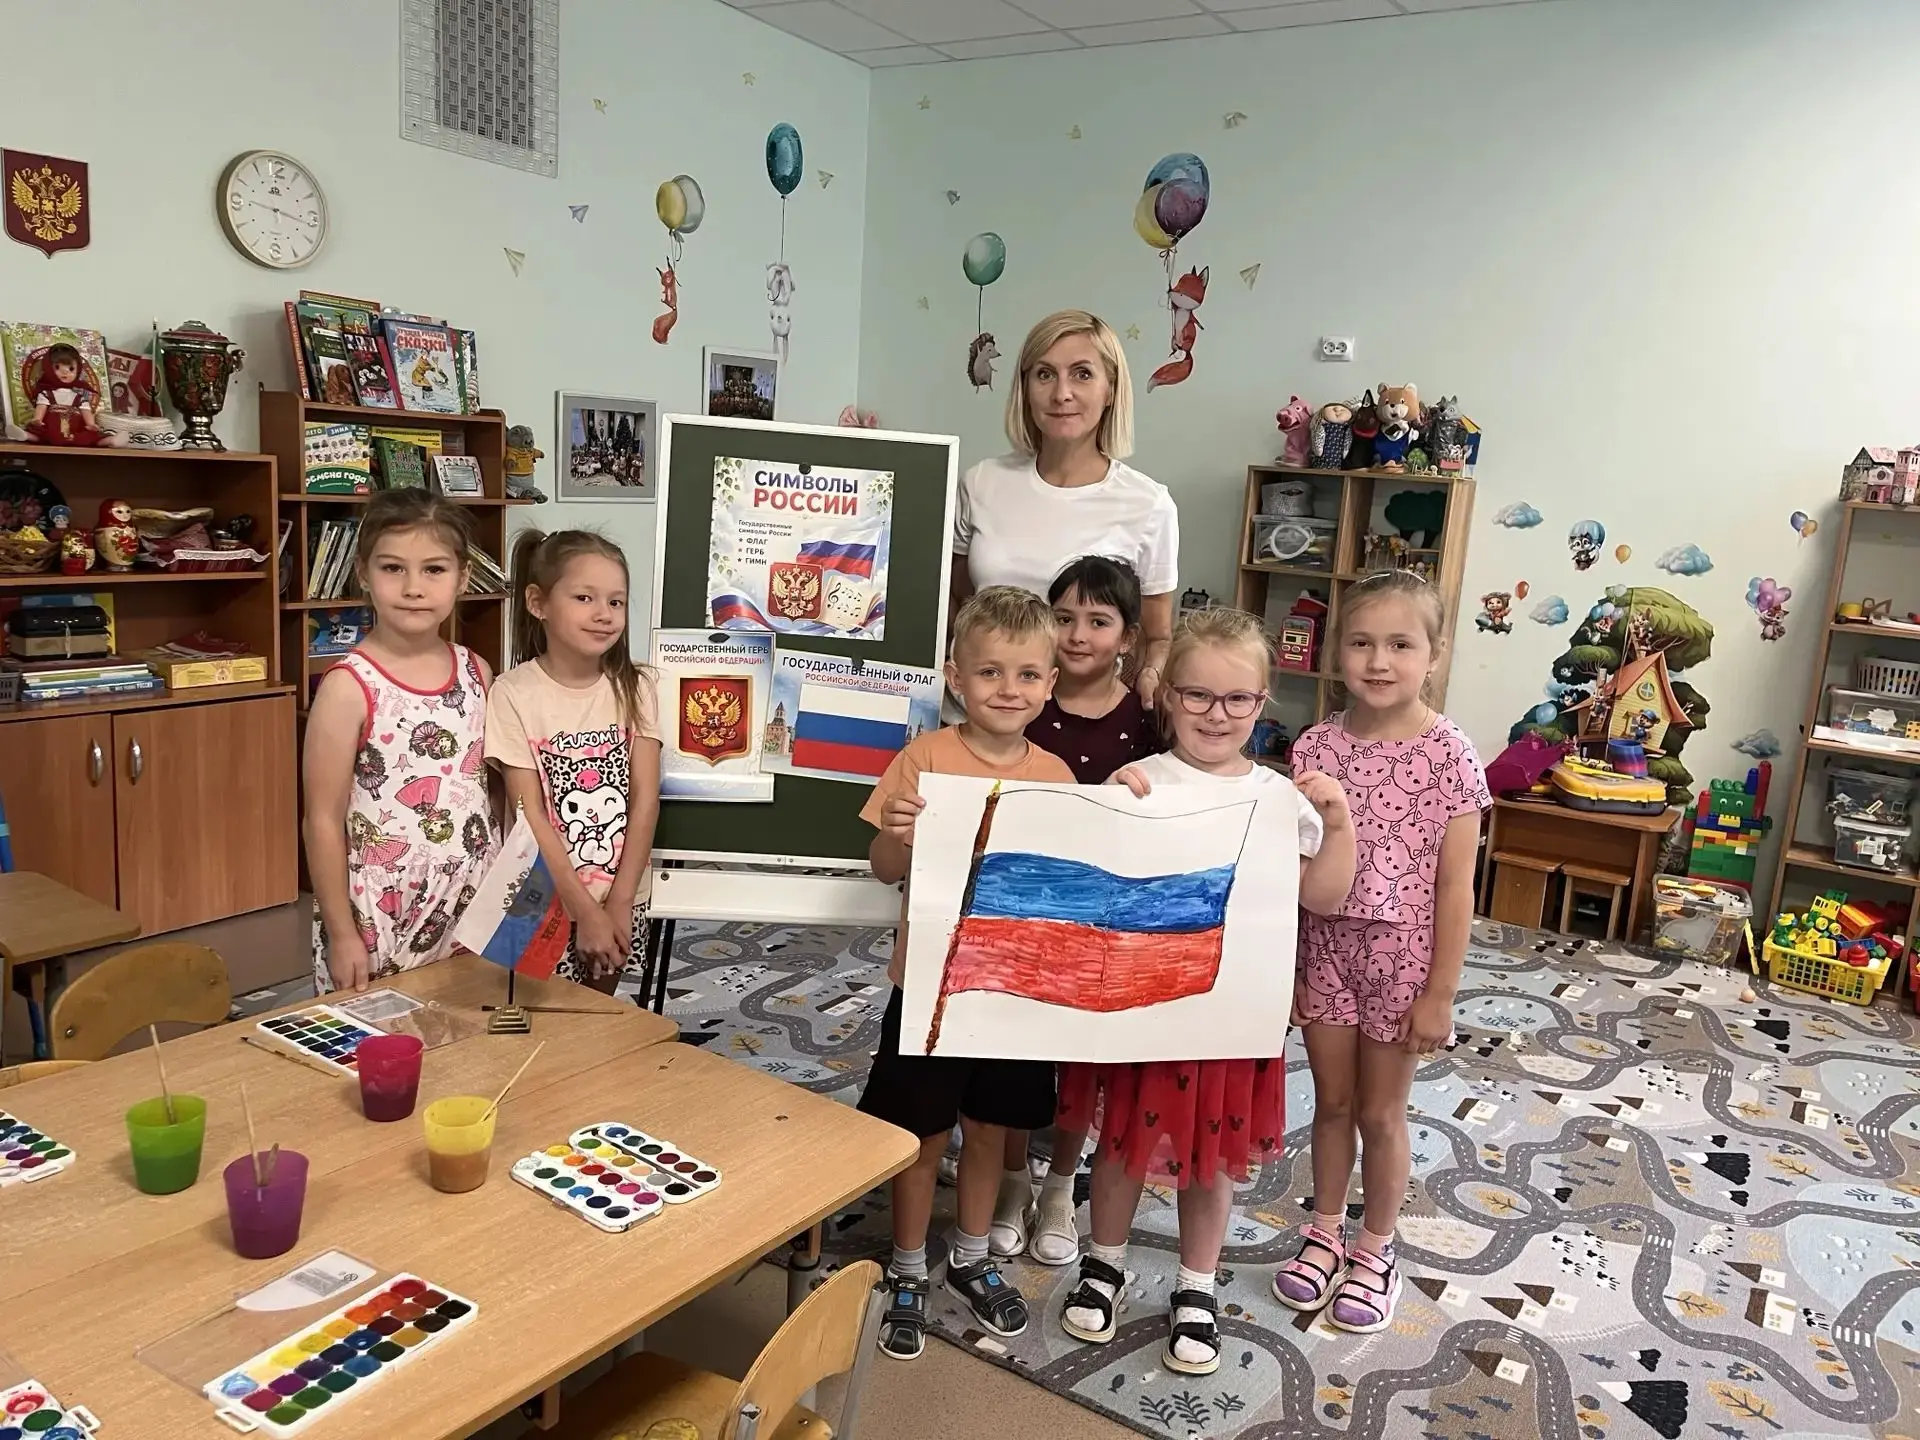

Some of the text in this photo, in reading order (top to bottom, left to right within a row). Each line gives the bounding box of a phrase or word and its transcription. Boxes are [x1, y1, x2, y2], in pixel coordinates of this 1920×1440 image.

[331, 426, 349, 435] ЗИМА
[754, 470, 858, 494] СИМВОЛЫ
[753, 488, 858, 515] РОССИИ
[738, 520, 792, 529] Государственные
[769, 529, 791, 537] России
[746, 537, 768, 545] ФЛАГ
[746, 547, 765, 555] ГЕРБ
[745, 557, 767, 565] ГИМН
[659, 643, 769, 654] ГОСУДАРСТВЕННЫЙ ГЕРБ
[663, 654, 765, 665] РОССИЙСКОЙ ФЕДЕРАЦИИ
[782, 656, 936, 686] ГОСУДАРСТВЕННЫЙ ФЛАГ
[861, 680, 910, 692] ФЕДЕРАЦИИ
